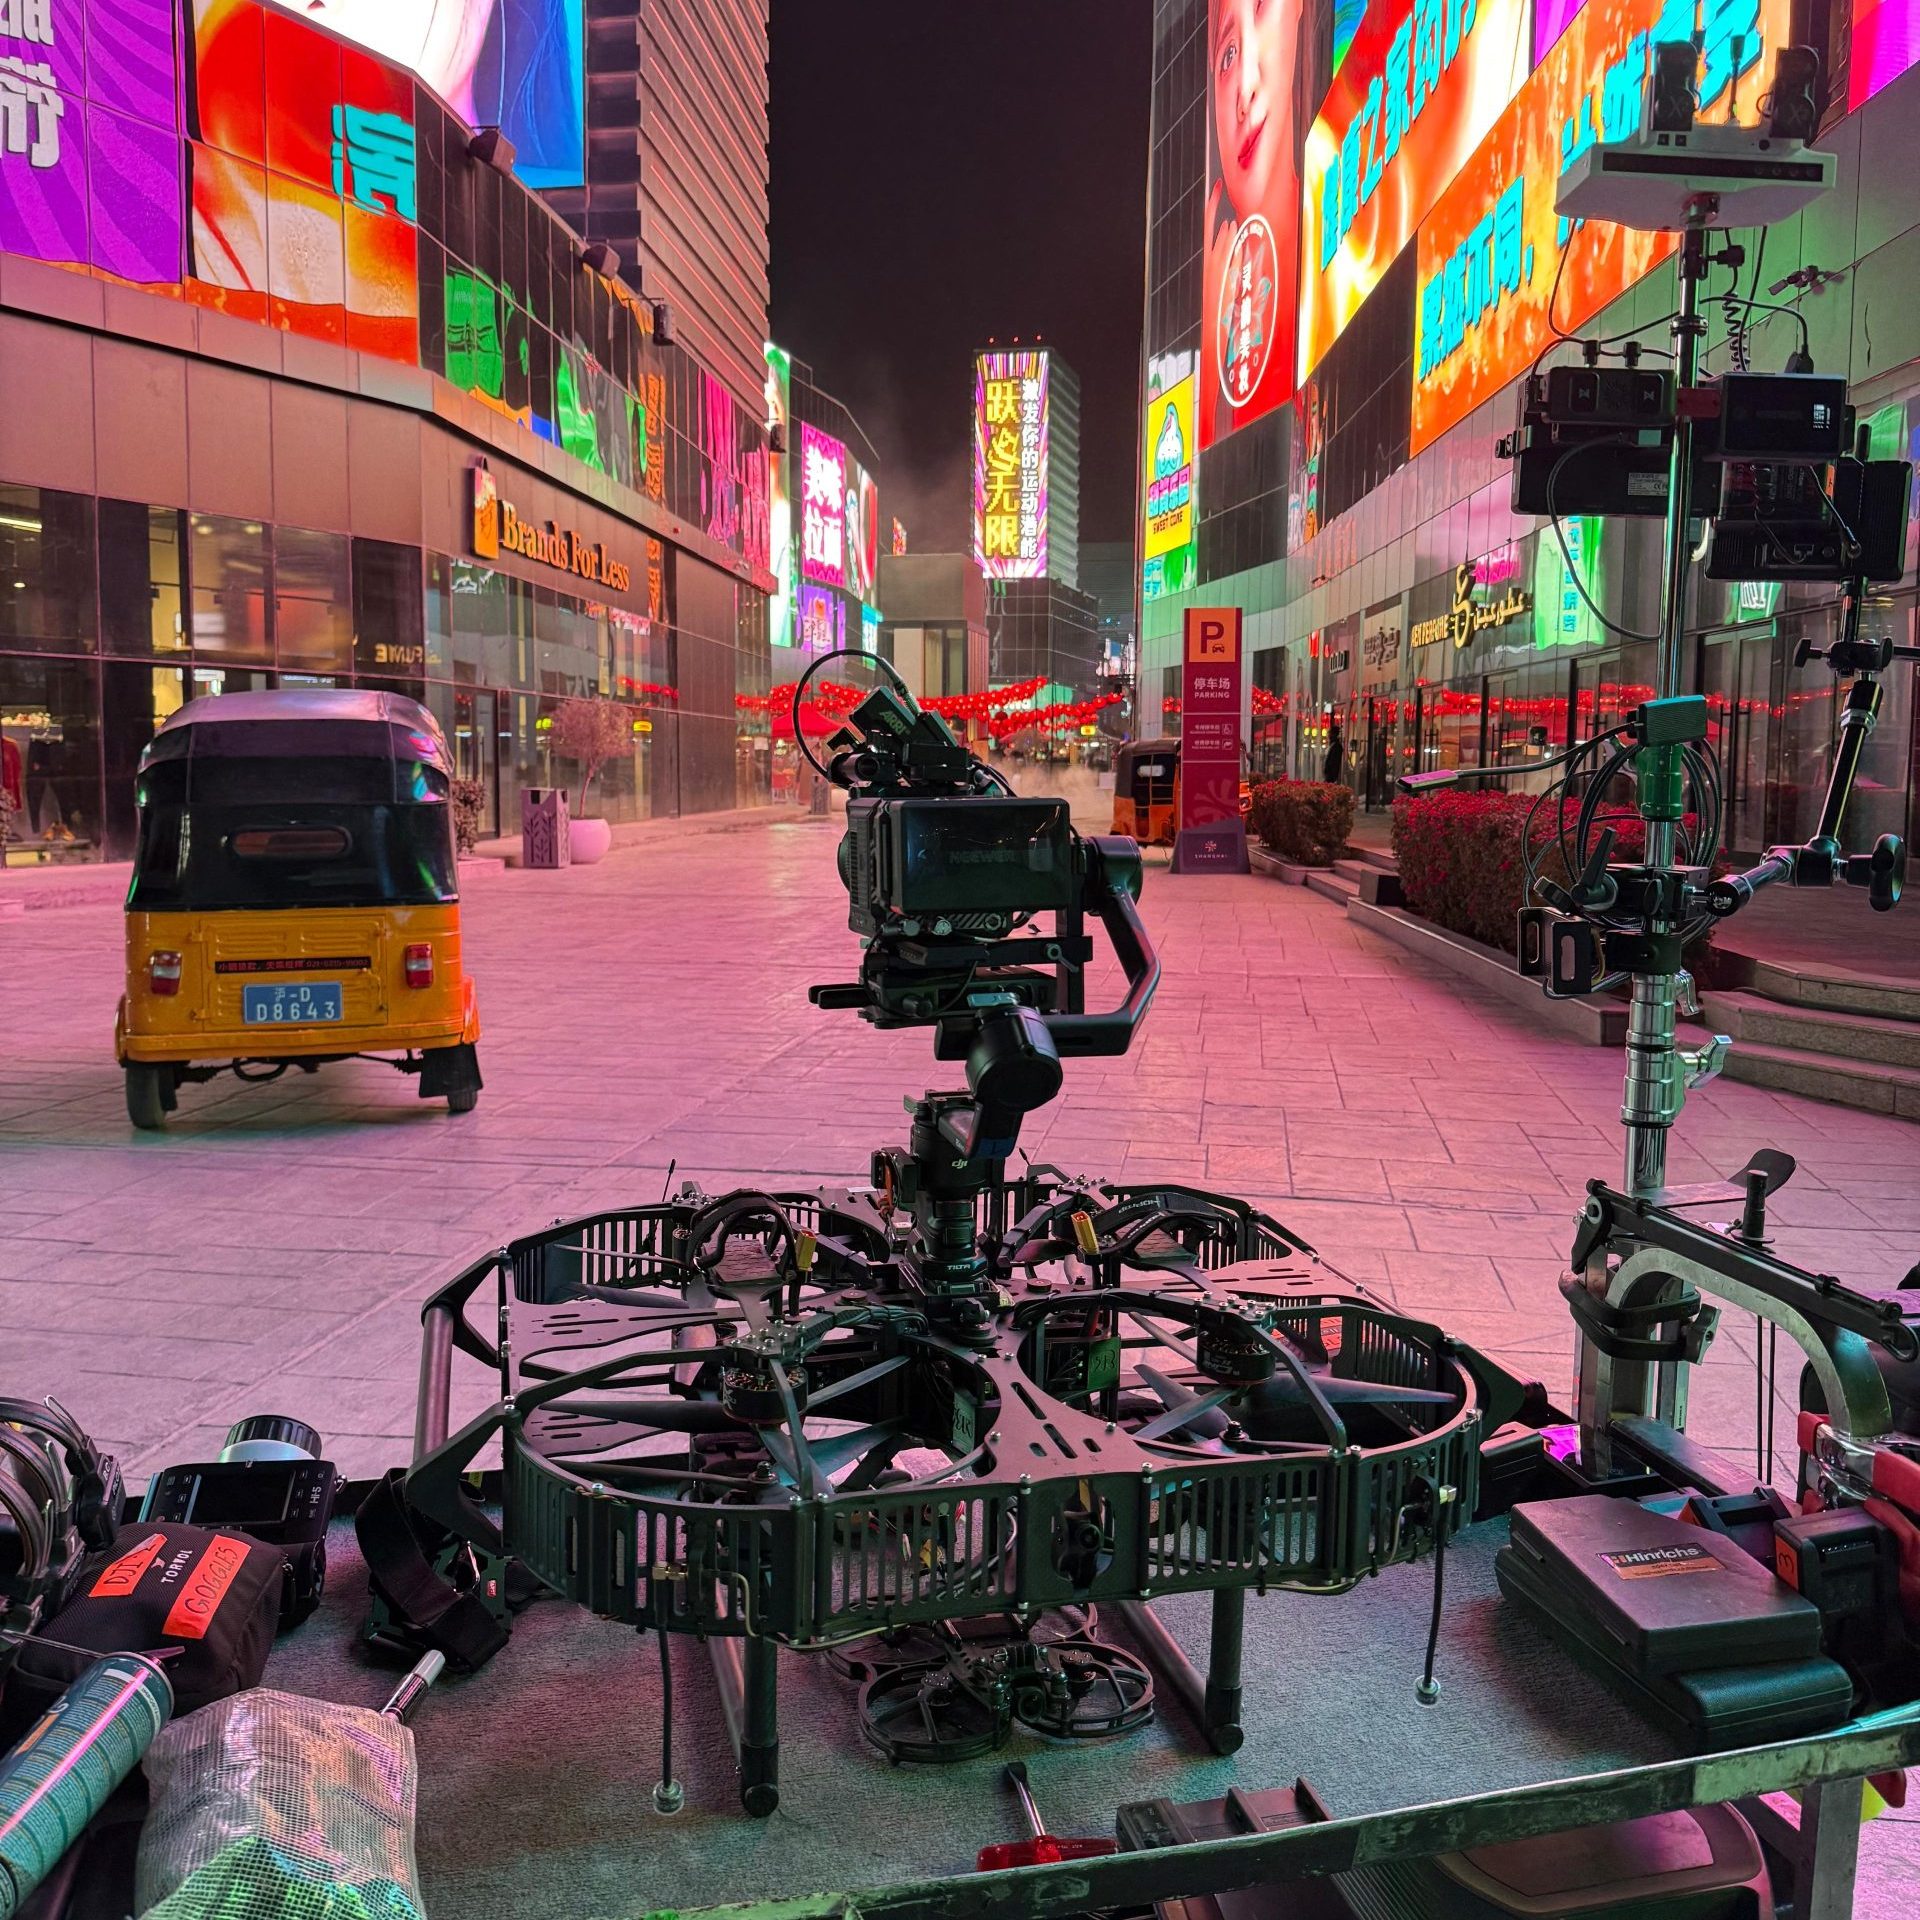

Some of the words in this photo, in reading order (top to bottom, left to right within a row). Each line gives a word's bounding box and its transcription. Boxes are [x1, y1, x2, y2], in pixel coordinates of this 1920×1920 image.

[502, 500, 568, 570] Brands
[570, 531, 598, 580] For
[601, 543, 630, 592] Less
[1200, 621, 1225, 654] P
[1194, 677, 1231, 690] 停车场
[880, 710, 909, 737] ARRI
[256, 1001, 335, 1021] D8643
[161, 1548, 193, 1583] TORVOL
[1626, 1547, 1700, 1564] Hinrichs
[184, 1546, 239, 1614] GOGGLES
